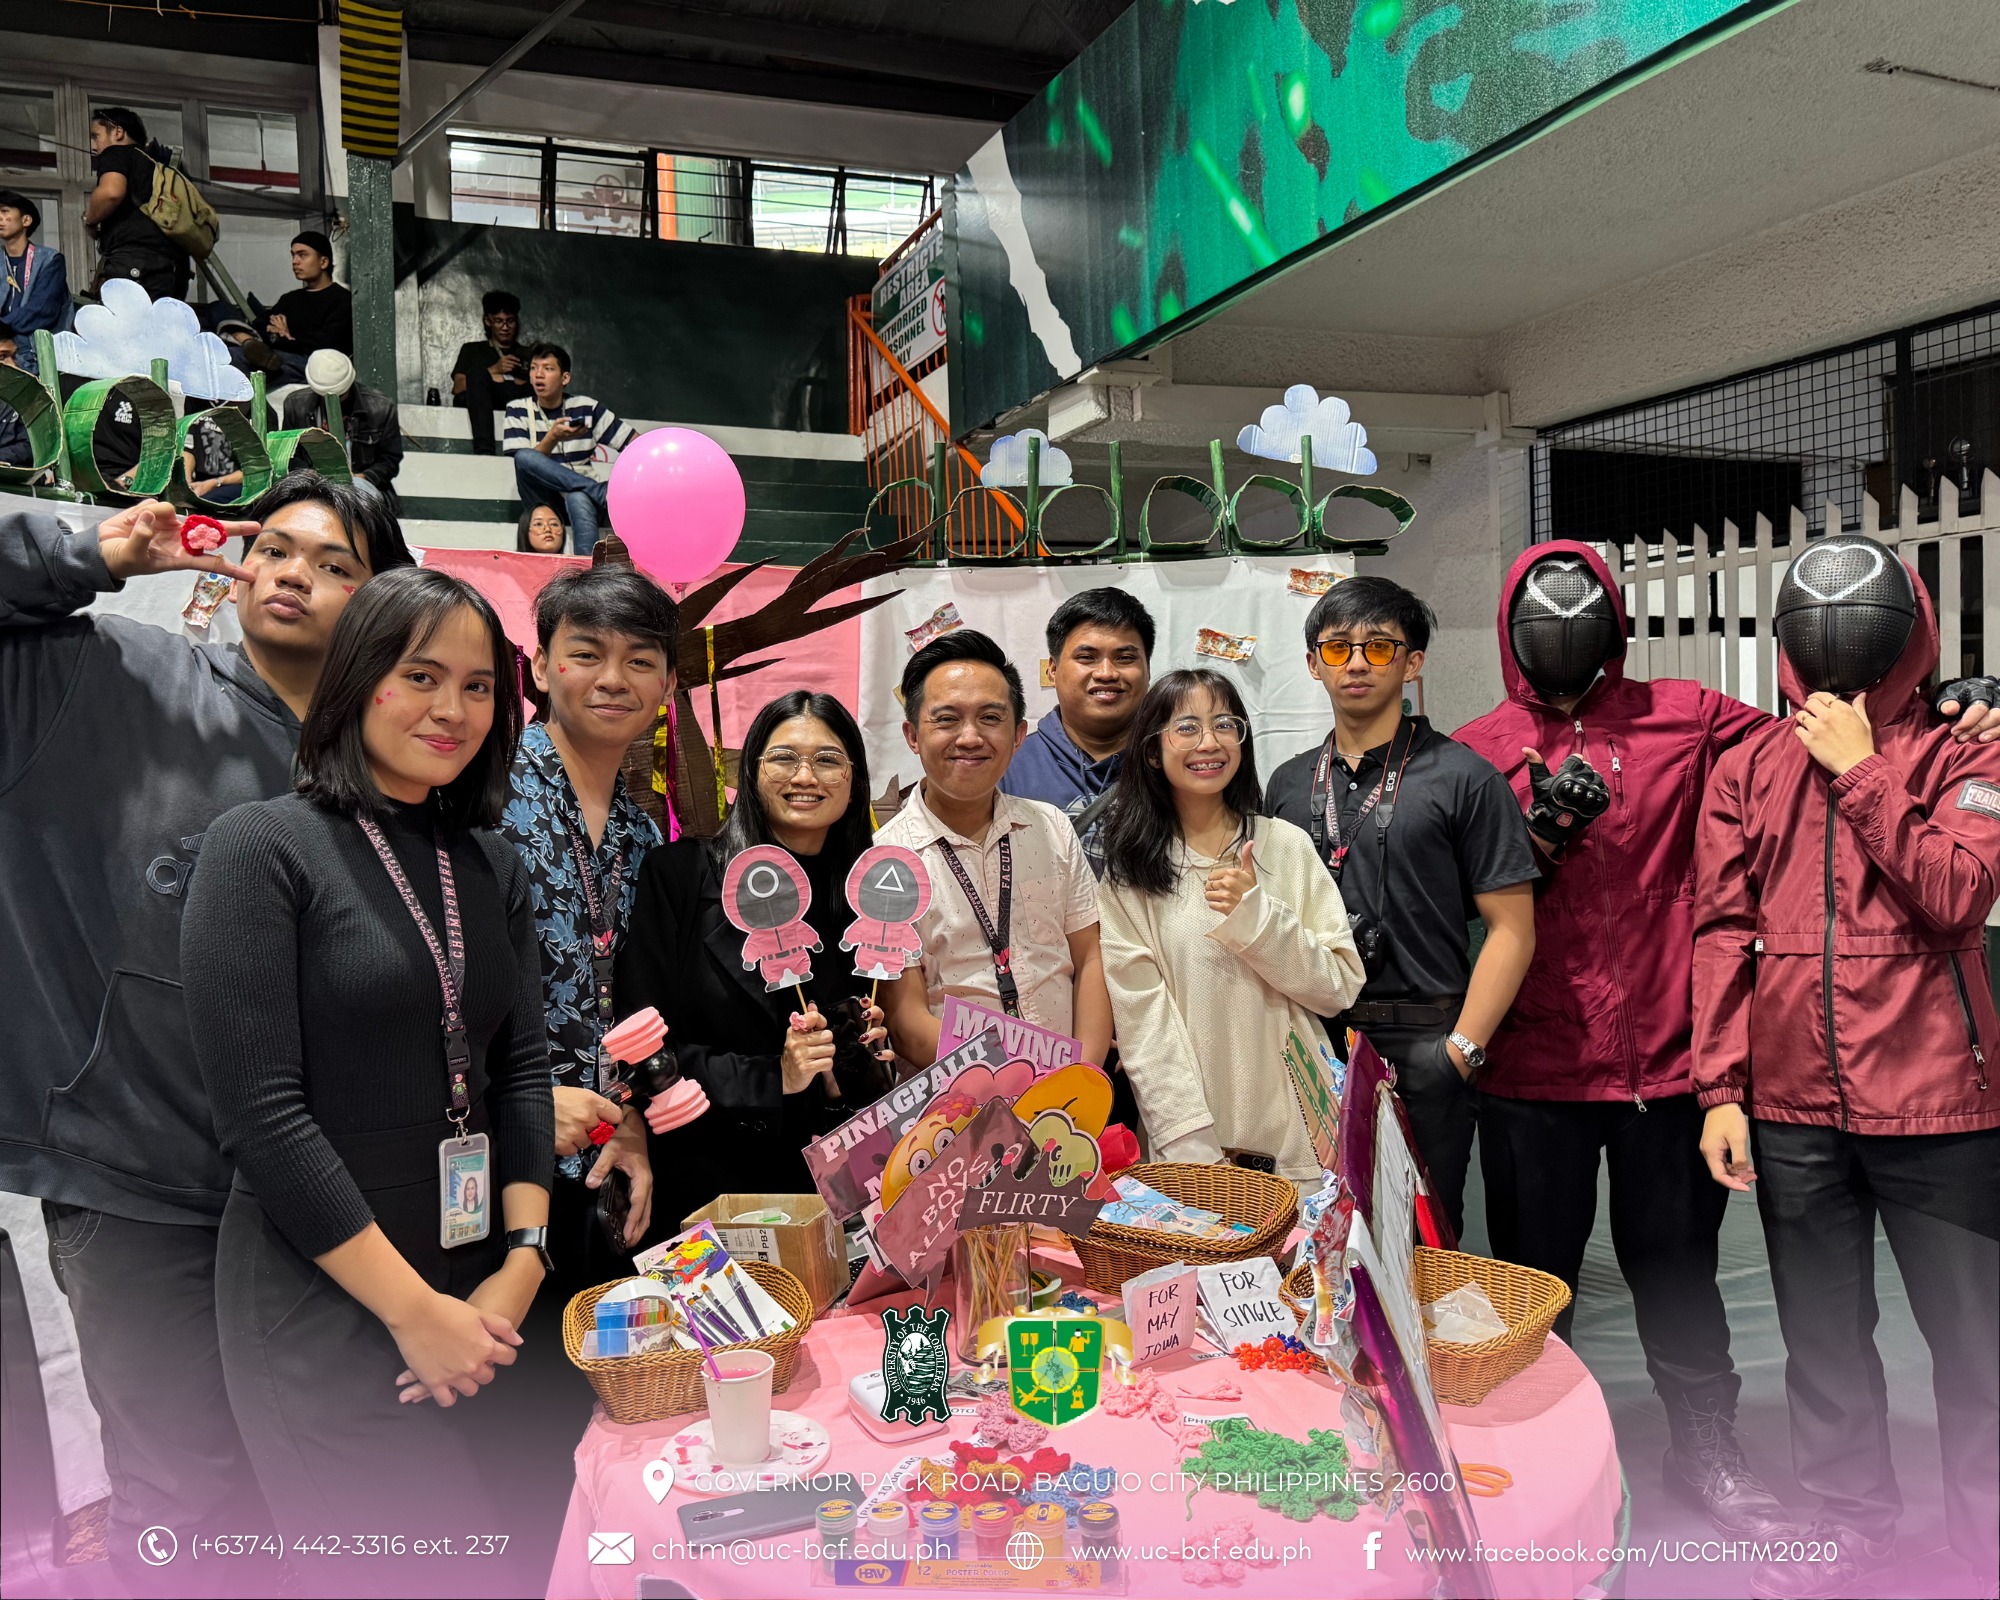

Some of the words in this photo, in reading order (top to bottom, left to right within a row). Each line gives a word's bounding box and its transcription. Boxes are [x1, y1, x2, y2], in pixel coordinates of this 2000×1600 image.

[880, 237, 943, 308] RESTRICTE
[899, 268, 930, 310] AREA
[886, 317, 926, 356] RSONNEL
[1318, 753, 1329, 783] Canon
[1385, 771, 1397, 792] EOS
[359, 819, 382, 850] COLLEGE
[384, 860, 413, 908] HOSPITALITY
[409, 906, 421, 922] AND
[418, 921, 437, 955] TOURISM
[434, 954, 454, 1009] MANAGEMENT
[369, 821, 406, 886] UNIVERSITY
[427, 928, 458, 1002] CORDILLERAS
[819, 1034, 988, 1163] PINAGPALIT
[921, 1154, 989, 1227] BOYS
[927, 1156, 965, 1201] NO
[976, 1191, 1079, 1217] FLIRTY
[1149, 1283, 1179, 1308] FOR
[1220, 1271, 1261, 1297] FOR
[1148, 1306, 1180, 1334] MAY
[1223, 1300, 1285, 1328] SINGLE
[1140, 1333, 1180, 1361] JOWA
[859, 1568, 886, 1579] HBW
